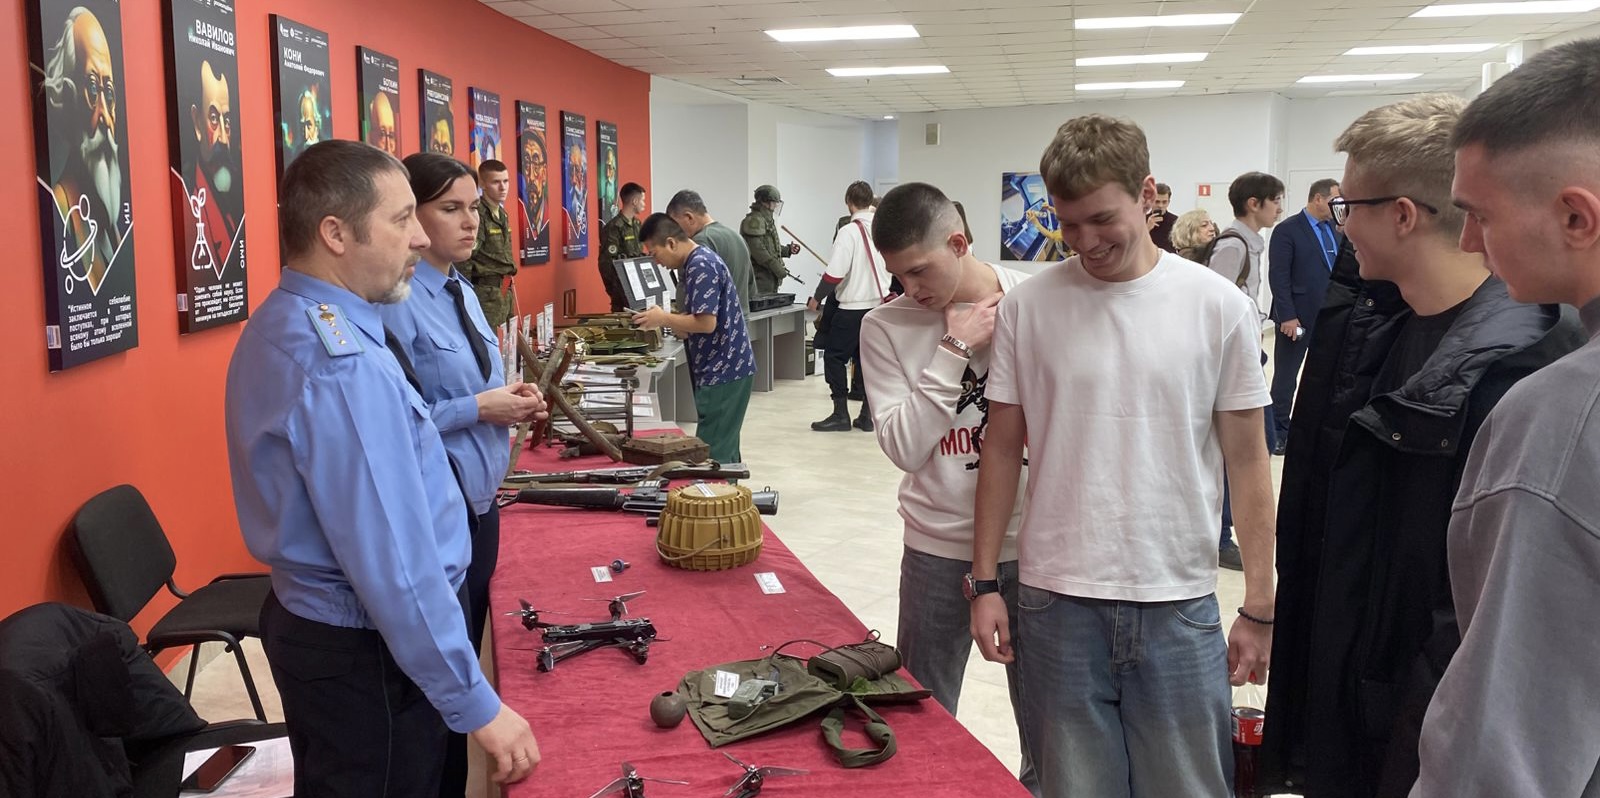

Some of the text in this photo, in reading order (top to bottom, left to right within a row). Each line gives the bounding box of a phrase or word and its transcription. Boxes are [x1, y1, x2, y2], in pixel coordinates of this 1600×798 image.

[195, 19, 234, 47] ВАВИЛОВ
[188, 33, 235, 57] Николай Иванович
[283, 46, 302, 63] КОНИ
[284, 59, 303, 72] Анатолий
[70, 342, 83, 351] было
[83, 338, 90, 348] бы
